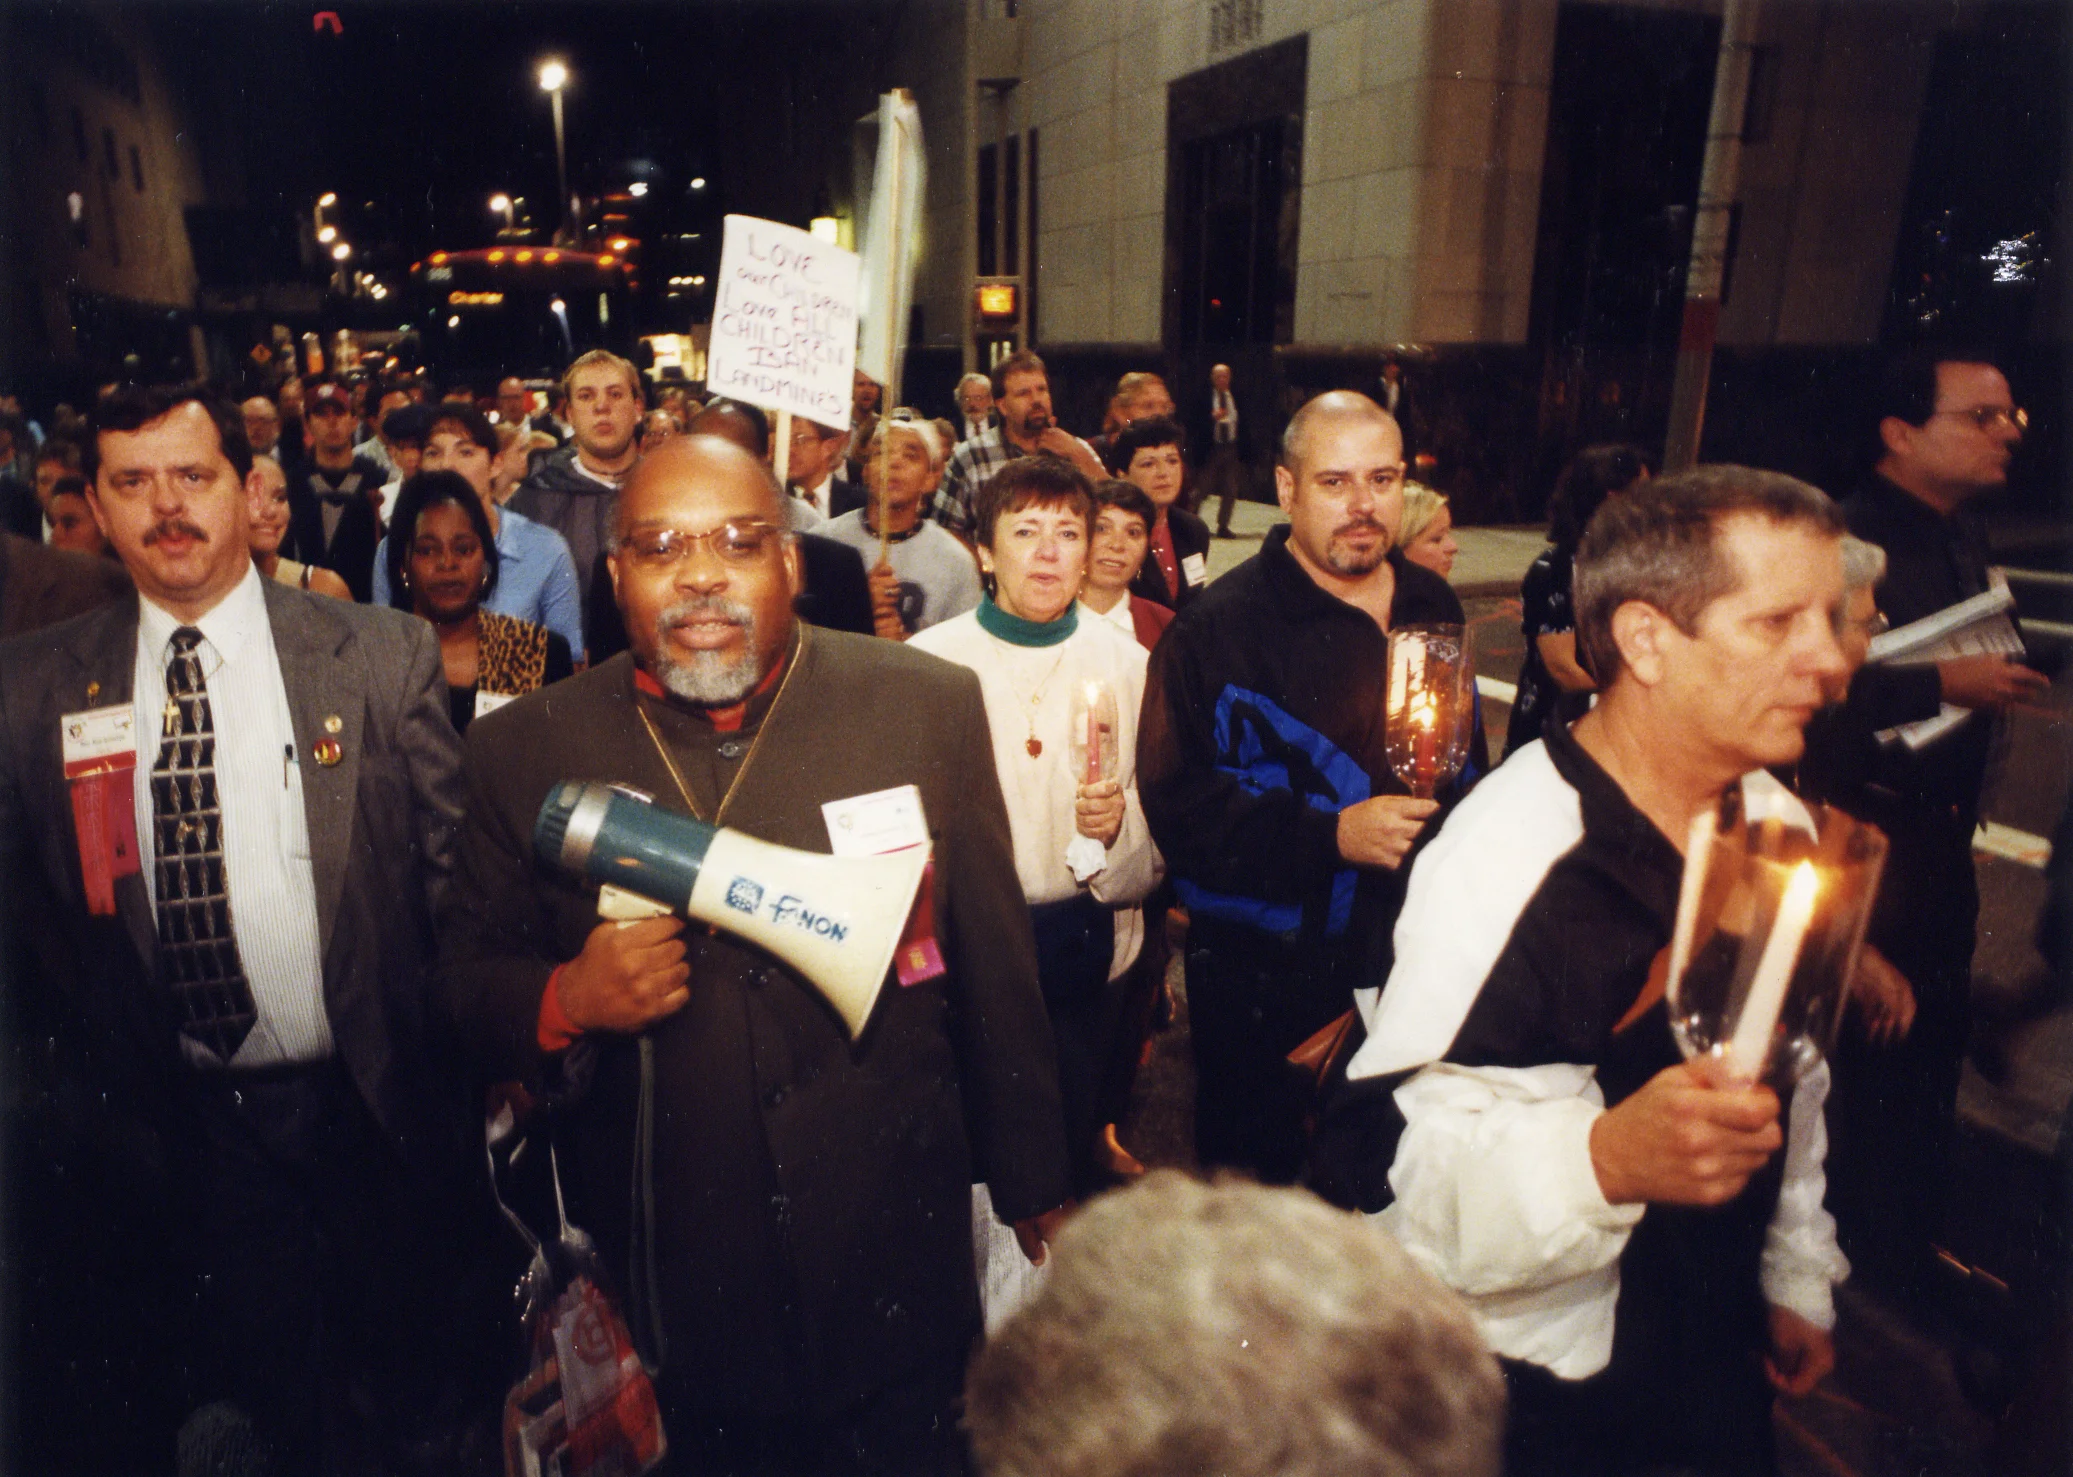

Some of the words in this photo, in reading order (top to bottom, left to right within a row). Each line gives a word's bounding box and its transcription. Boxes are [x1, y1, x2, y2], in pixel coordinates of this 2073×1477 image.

[748, 233, 823, 283] LOVE
[720, 313, 844, 366] CHILDREN
[769, 894, 848, 942] FNON
